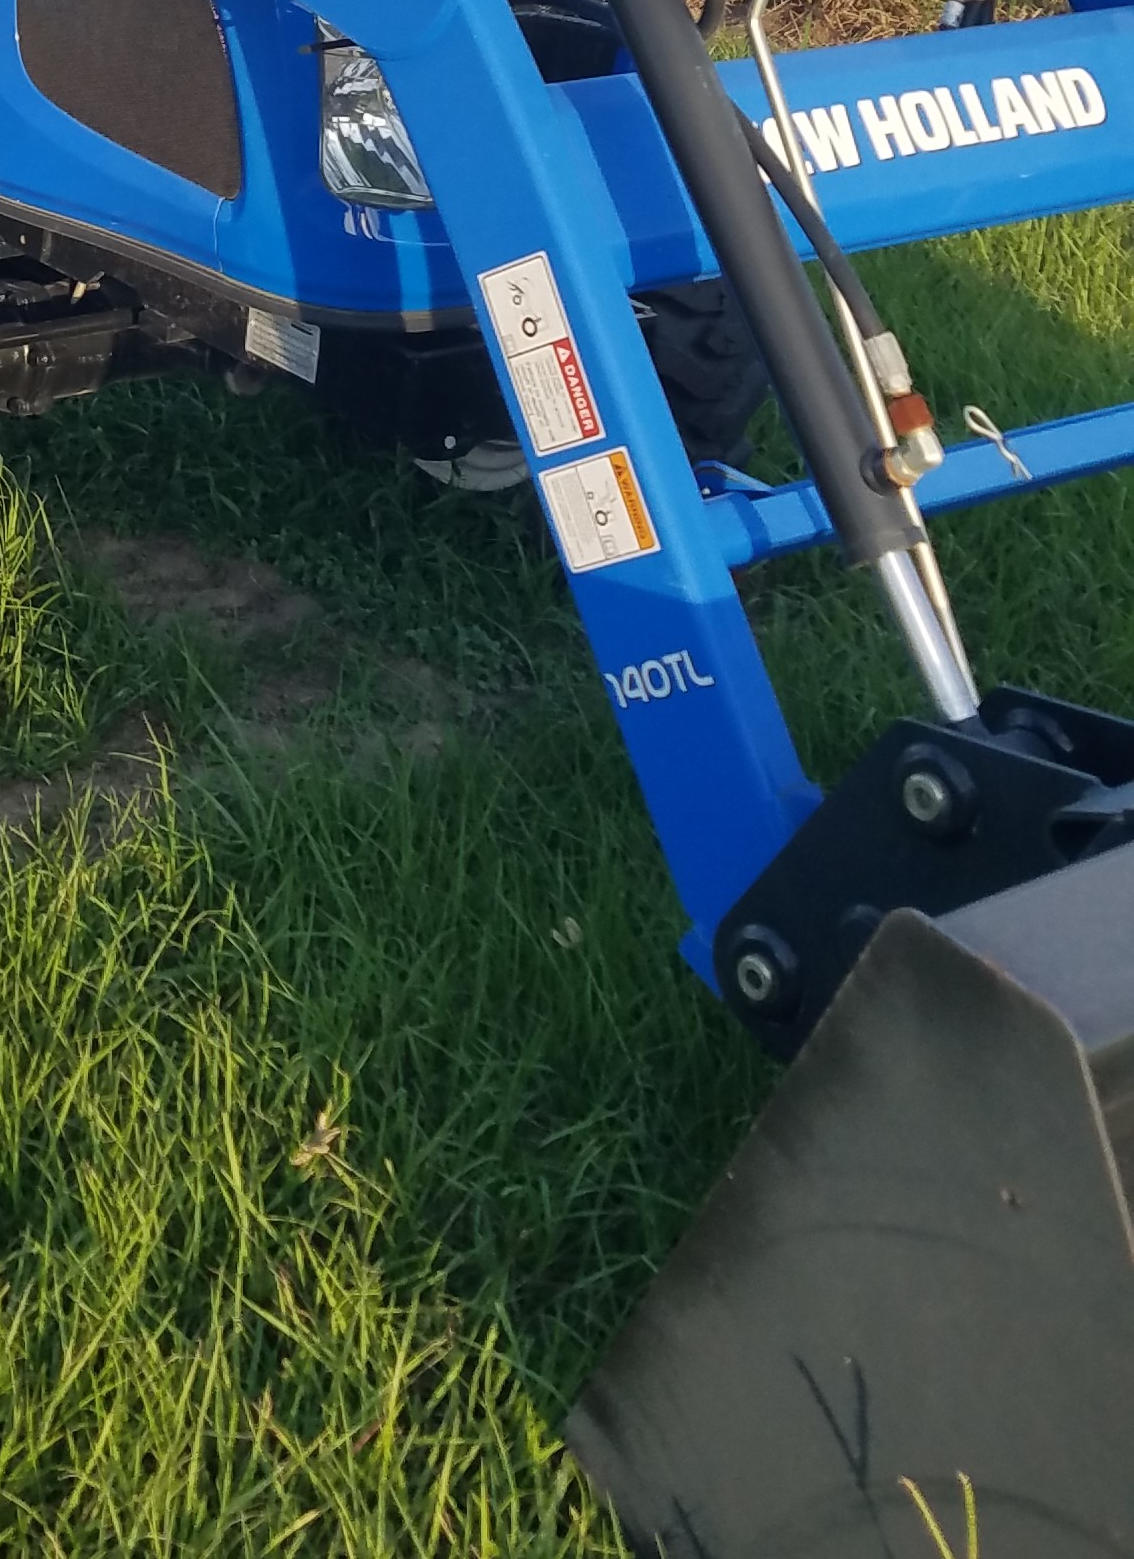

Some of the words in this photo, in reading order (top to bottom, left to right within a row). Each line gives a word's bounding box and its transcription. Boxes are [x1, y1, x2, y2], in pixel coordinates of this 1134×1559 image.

[752, 103, 861, 183] EW
[856, 66, 1108, 161] HOLLAND
[564, 363, 595, 432] DANGER
